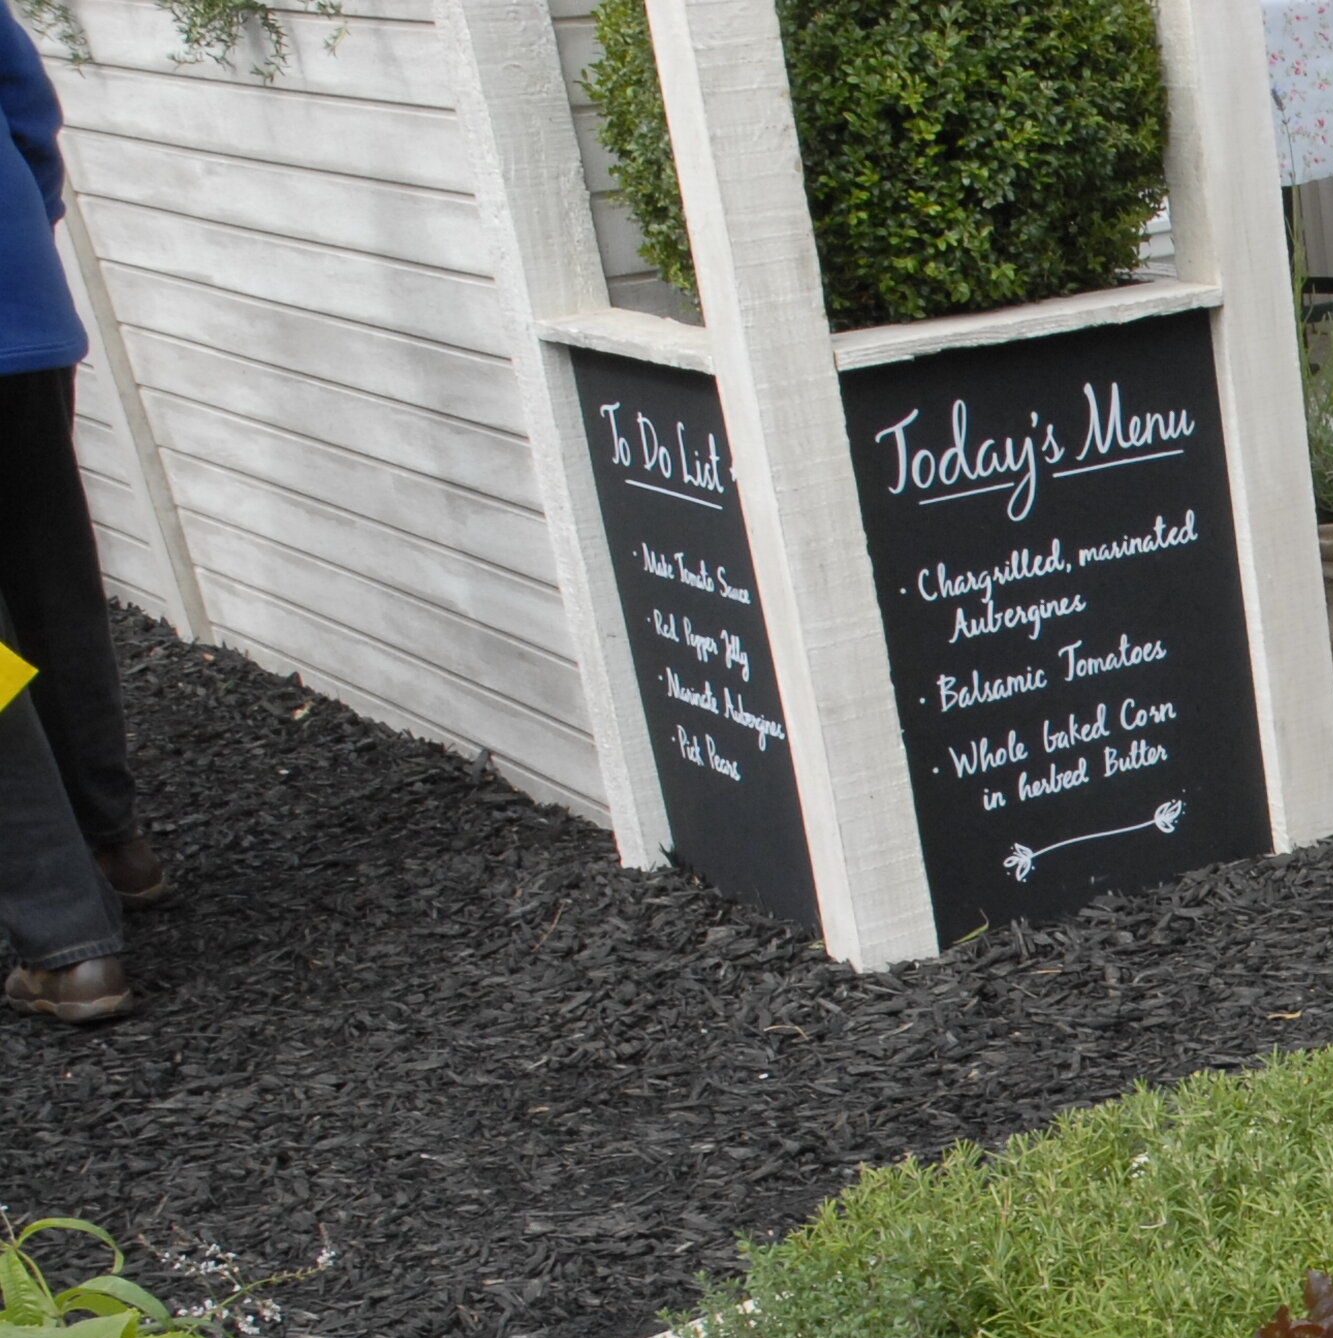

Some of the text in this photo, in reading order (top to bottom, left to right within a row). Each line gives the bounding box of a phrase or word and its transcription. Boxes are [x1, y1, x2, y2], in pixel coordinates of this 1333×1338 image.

[600, 402, 724, 493] To Do List
[874, 382, 1195, 522] Today's Menu
[642, 542, 751, 604] Make Tomato Sauce
[918, 509, 1198, 603] Chargrilled, marinated
[653, 609, 680, 643] Red
[683, 616, 718, 662] Pepper
[948, 594, 1087, 644] Aubergines
[666, 667, 719, 714] Marinate
[937, 634, 1167, 712] Balsamic Tomatoes
[676, 724, 741, 781] Pick Pears
[949, 698, 1177, 778] Whole baked Corn
[983, 739, 1168, 811] in herbed Butter
